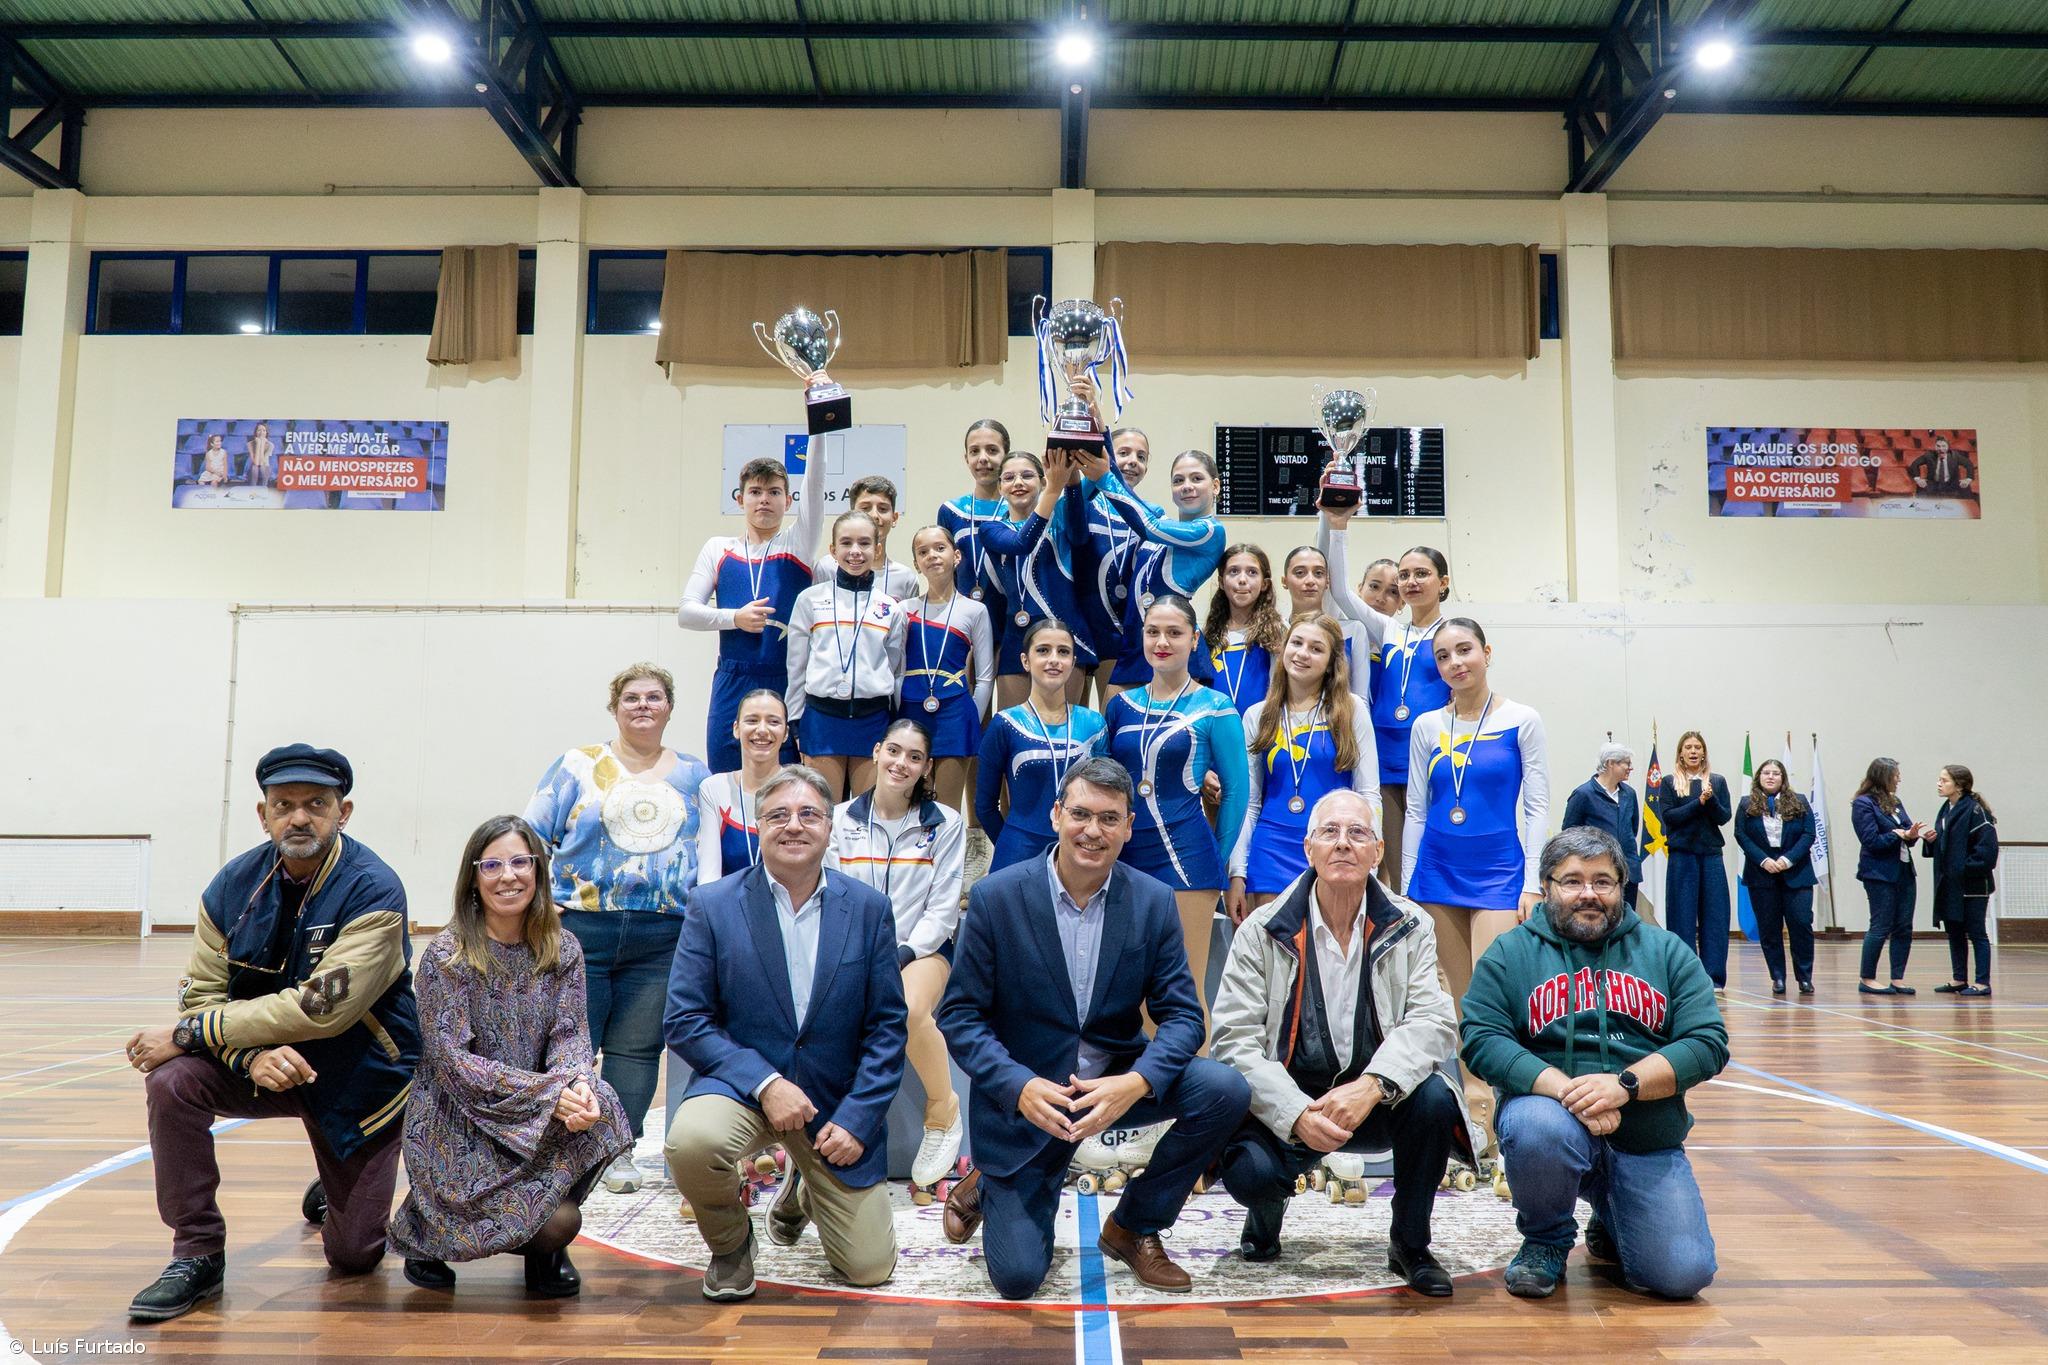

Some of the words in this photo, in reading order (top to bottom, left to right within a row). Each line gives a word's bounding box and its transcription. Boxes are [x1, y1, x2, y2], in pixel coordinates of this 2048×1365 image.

[285, 431, 389, 444] ENTUSIASMA-TE
[284, 444, 294, 454] A
[299, 444, 346, 454] VER-ME
[351, 445, 400, 456] JOGAR
[1733, 443, 1793, 454] APLAUDE
[1797, 443, 1818, 454] OS
[1821, 443, 1858, 454] BONS
[283, 458, 315, 472] NÃO
[320, 461, 415, 473] MENOSPREZES
[1274, 455, 1308, 464] VISITADO
[1349, 456, 1387, 465] VITANTE
[1733, 455, 1812, 466] MOMENTOS
[1815, 456, 1836, 467] DO
[1840, 456, 1882, 467] JOGO
[282, 475, 294, 486] O
[298, 475, 326, 486] MEU
[330, 473, 419, 487] ADVERSÁRIO
[1733, 469, 1766, 483] NÃO
[1770, 472, 1840, 484] CRITIQUES
[1734, 486, 1746, 497] O
[1750, 484, 1836, 498] ADVERSÁRIO
